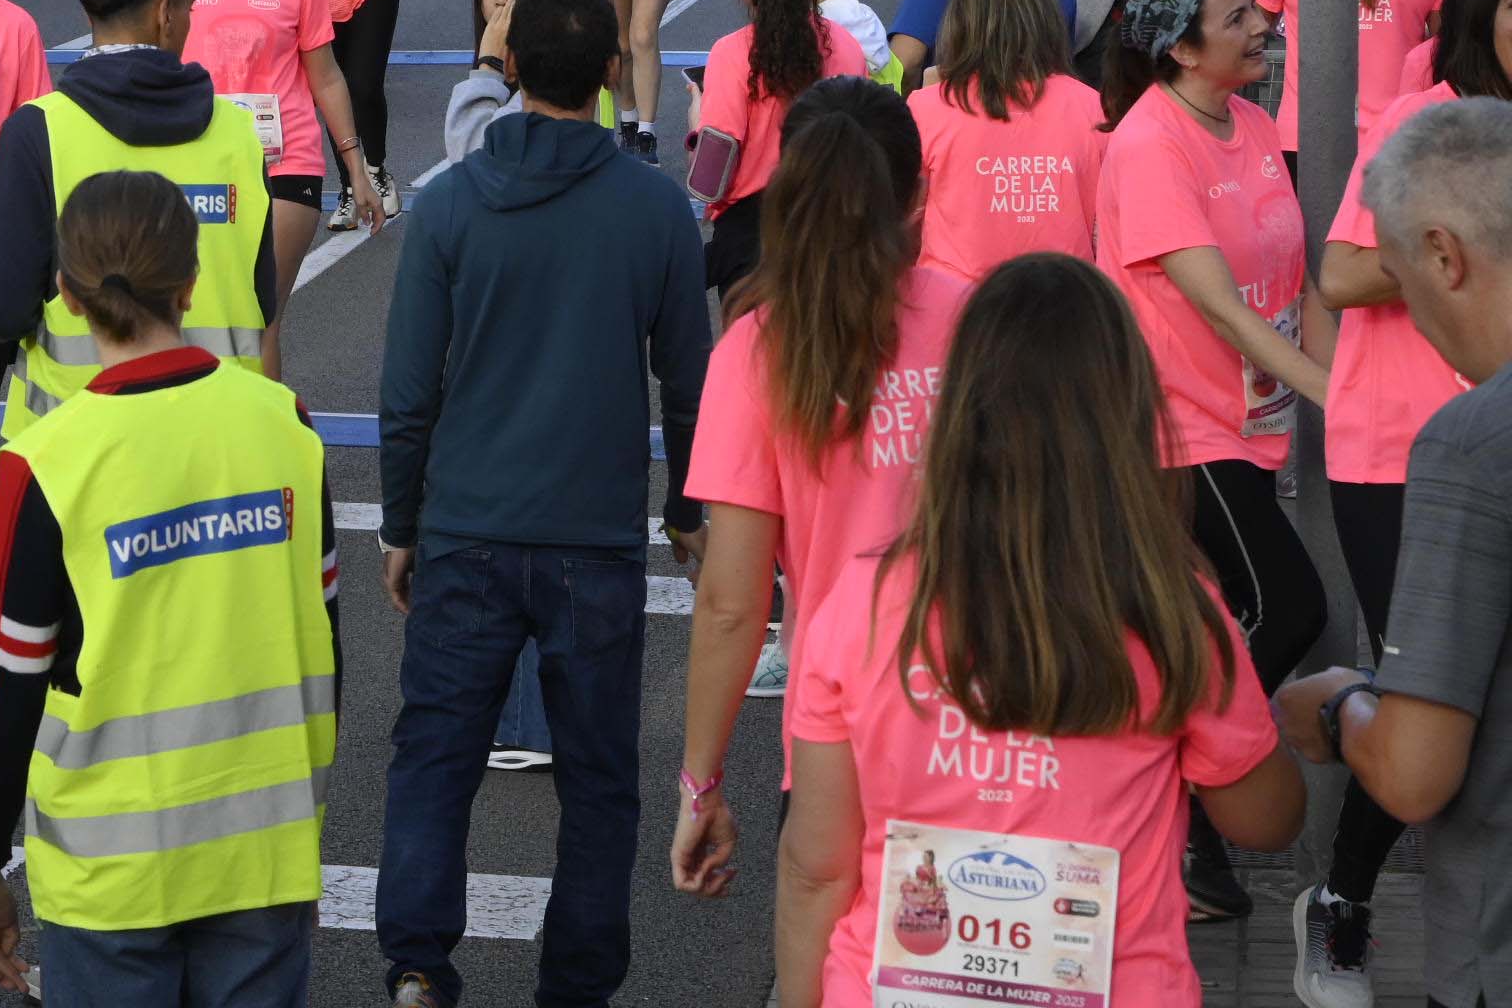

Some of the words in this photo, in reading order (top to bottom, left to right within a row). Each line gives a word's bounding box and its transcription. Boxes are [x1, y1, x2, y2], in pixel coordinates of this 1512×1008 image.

[976, 155, 1073, 176] CARRERA
[995, 176, 1021, 194] DE
[1031, 176, 1056, 194] LA
[990, 194, 1059, 213] MUJER
[1238, 280, 1267, 308] TU
[872, 401, 915, 434] DE
[1253, 416, 1286, 430] OYSHO
[111, 503, 284, 564] VOLUNTARIS
[927, 741, 1061, 791] MUJER
[978, 789, 1014, 803] 2023
[955, 865, 1039, 892] ASTURIANA
[1055, 871, 1101, 885] SUMA
[958, 914, 1032, 950] 016
[963, 954, 1020, 977] 29371
[901, 974, 963, 993] CARRERA
[966, 982, 985, 996] DE
[986, 985, 1004, 998] LA
[1006, 986, 1051, 1003] MUJER
